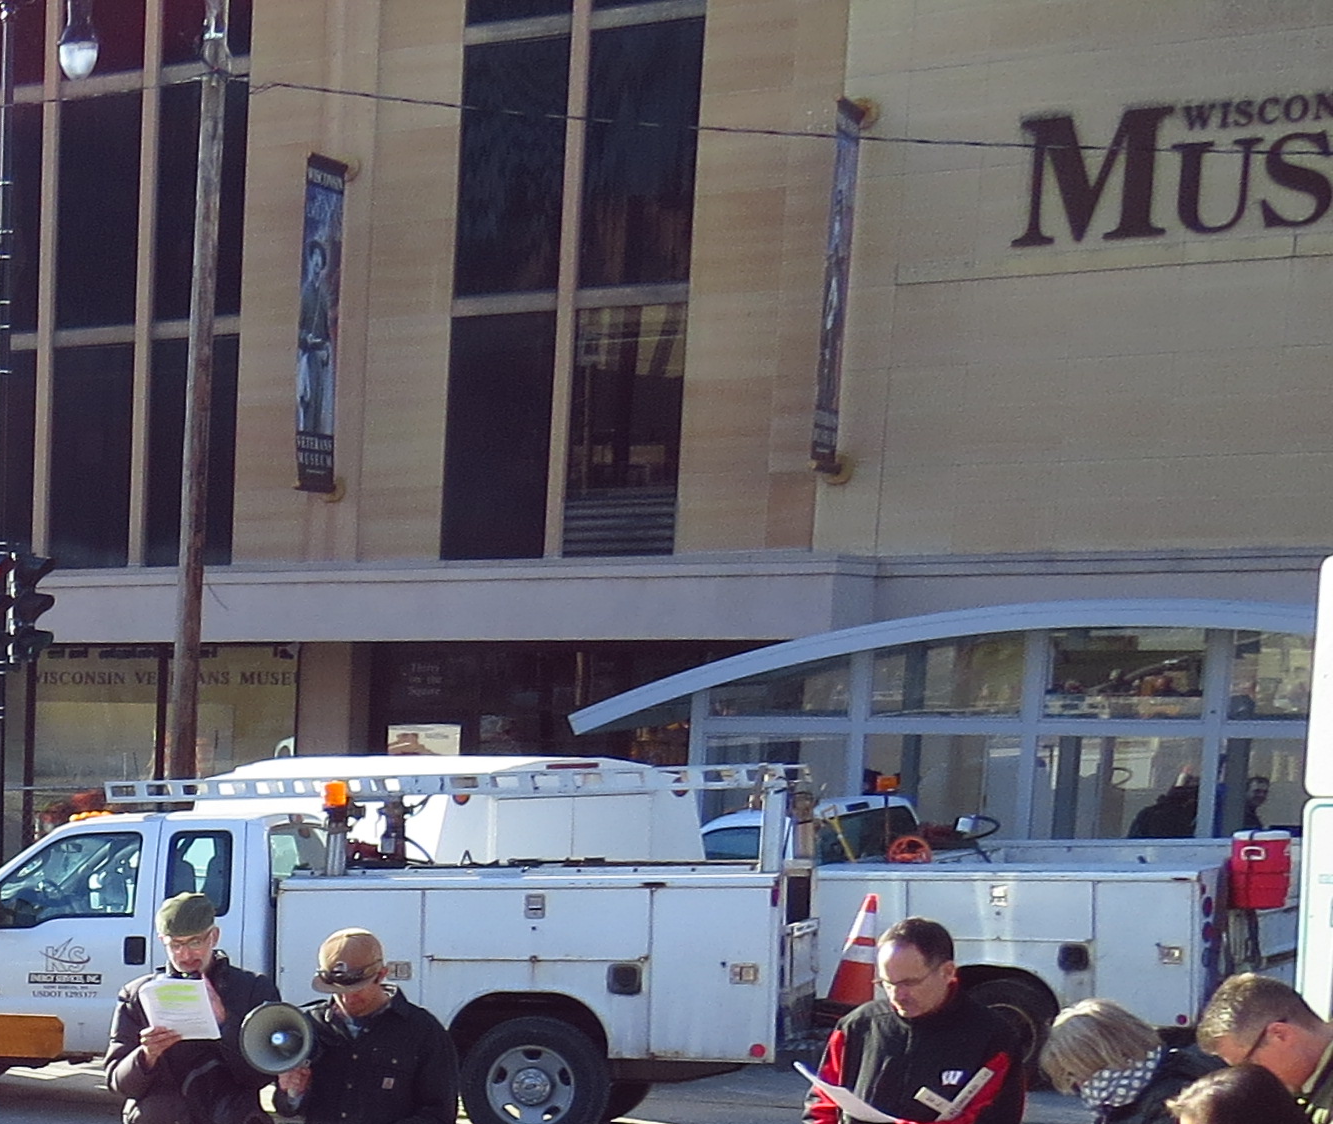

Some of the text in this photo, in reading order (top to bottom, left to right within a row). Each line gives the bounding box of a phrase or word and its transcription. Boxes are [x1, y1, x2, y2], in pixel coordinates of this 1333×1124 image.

[1010, 105, 1333, 248] MUS
[134, 671, 230, 686] VEANS
[32, 990, 61, 998] USDOT
[941, 1070, 964, 1087] W
